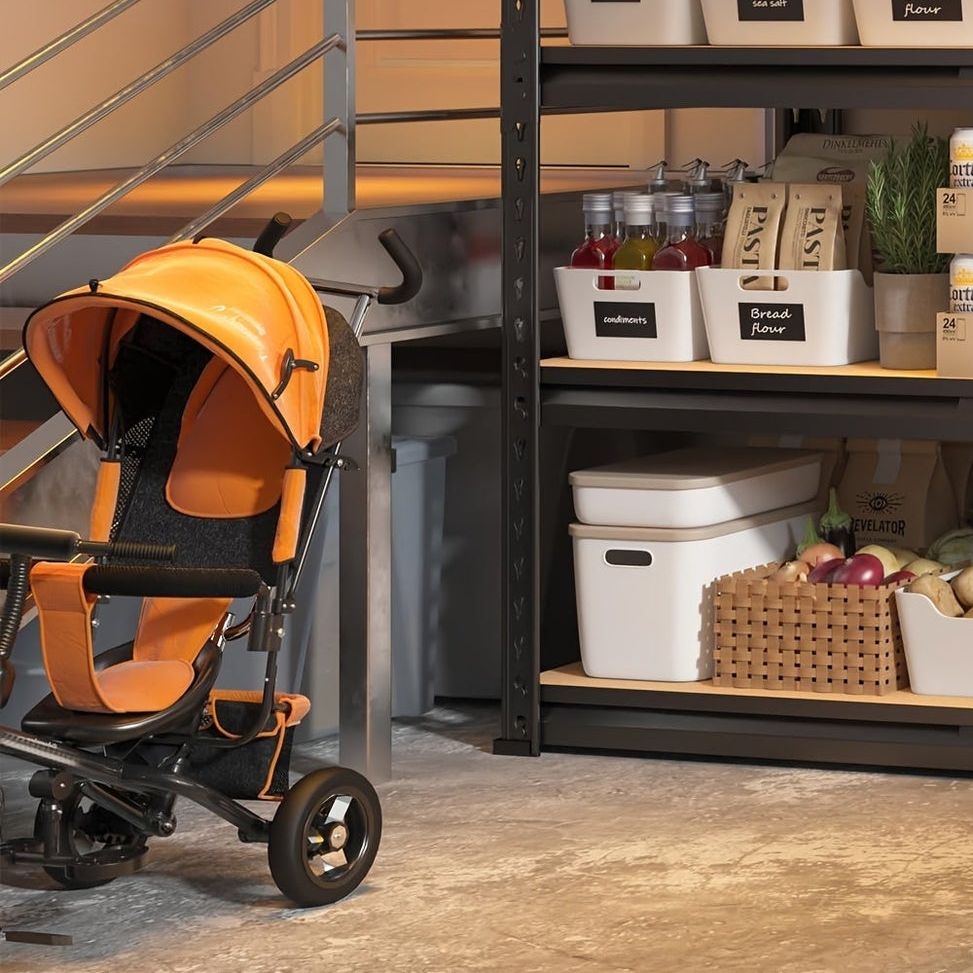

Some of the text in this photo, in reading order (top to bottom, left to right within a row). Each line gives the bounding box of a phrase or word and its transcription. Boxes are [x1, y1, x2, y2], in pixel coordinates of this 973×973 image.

[752, 0, 768, 8] sea
[903, 3, 942, 18] flour
[943, 193, 956, 204] 24
[803, 207, 826, 270] PAST
[750, 308, 792, 319] Bread
[603, 315, 648, 325] condiments
[943, 318, 956, 329] 24
[750, 322, 786, 336] flour
